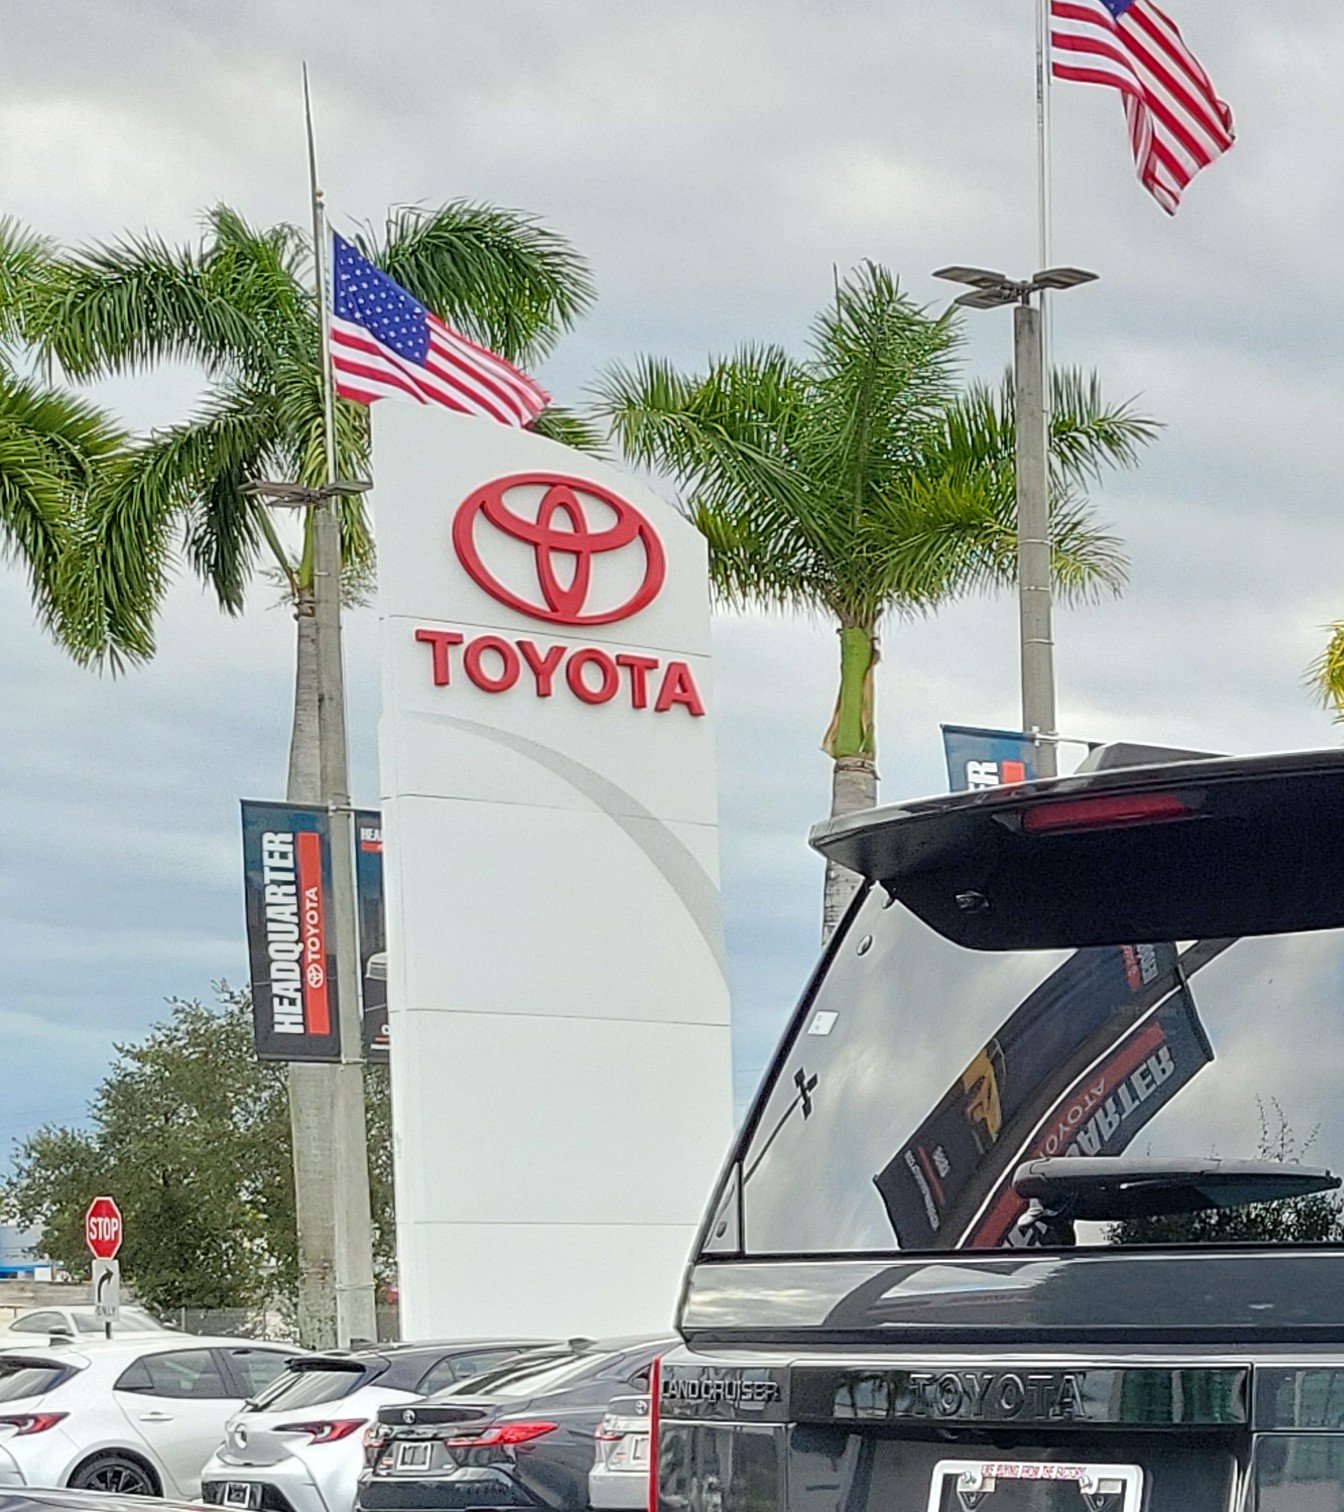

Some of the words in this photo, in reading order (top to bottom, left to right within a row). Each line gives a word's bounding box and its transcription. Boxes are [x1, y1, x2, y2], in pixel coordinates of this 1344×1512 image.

[414, 627, 706, 718] TOYOTA
[262, 831, 305, 1035] HEADQUARTER
[304, 886, 323, 962] TOYOTA
[89, 1216, 119, 1241] STOP
[907, 1371, 1088, 1420] TOYOTA
